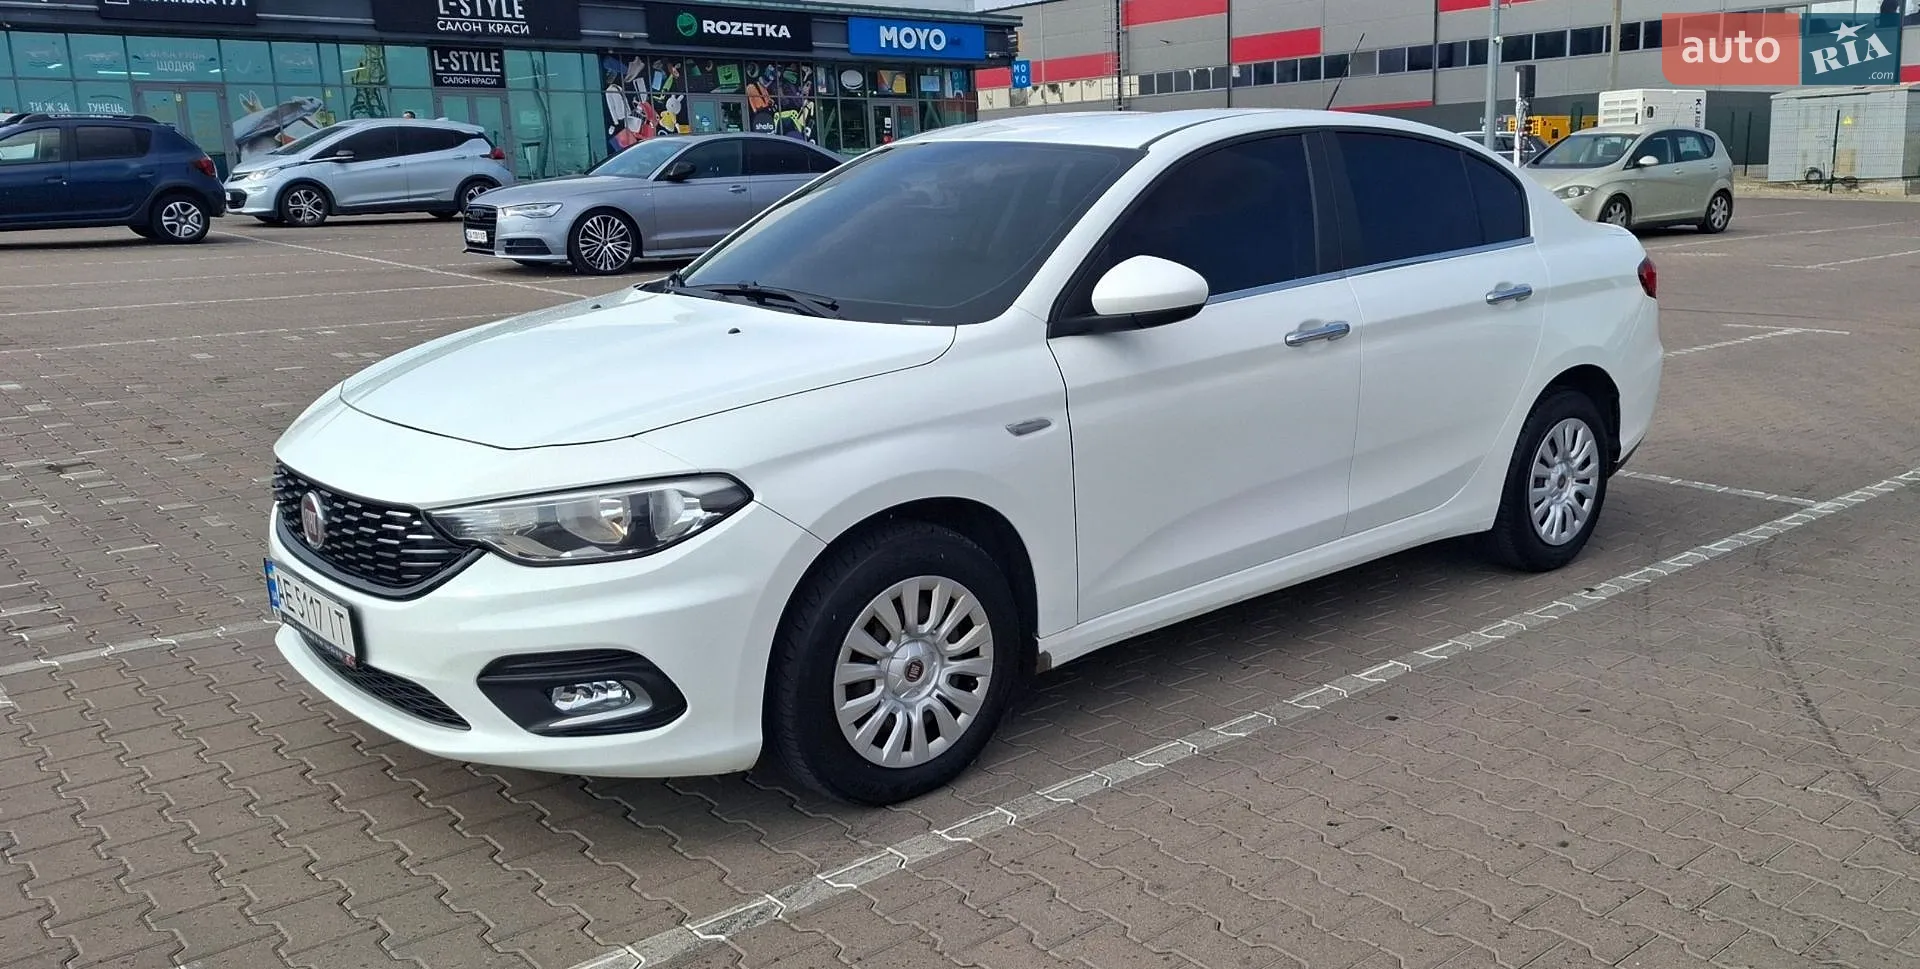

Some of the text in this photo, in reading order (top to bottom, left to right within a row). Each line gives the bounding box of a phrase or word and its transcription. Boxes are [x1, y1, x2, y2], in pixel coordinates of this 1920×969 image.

[437, 20, 530, 34] САЛОН КРАСИ
[702, 20, 791, 38] ROZETKA
[879, 25, 946, 50] MOYO
[156, 60, 195, 72] ЩОДНЯ
[433, 49, 501, 72] L-STYLE
[1013, 64, 1027, 73] MO
[442, 76, 497, 85] САЛОН КРАСИ
[1014, 75, 1027, 84] YO
[29, 102, 42, 112] ТИ
[45, 102, 54, 112] Ж
[57, 102, 70, 113] ЗА
